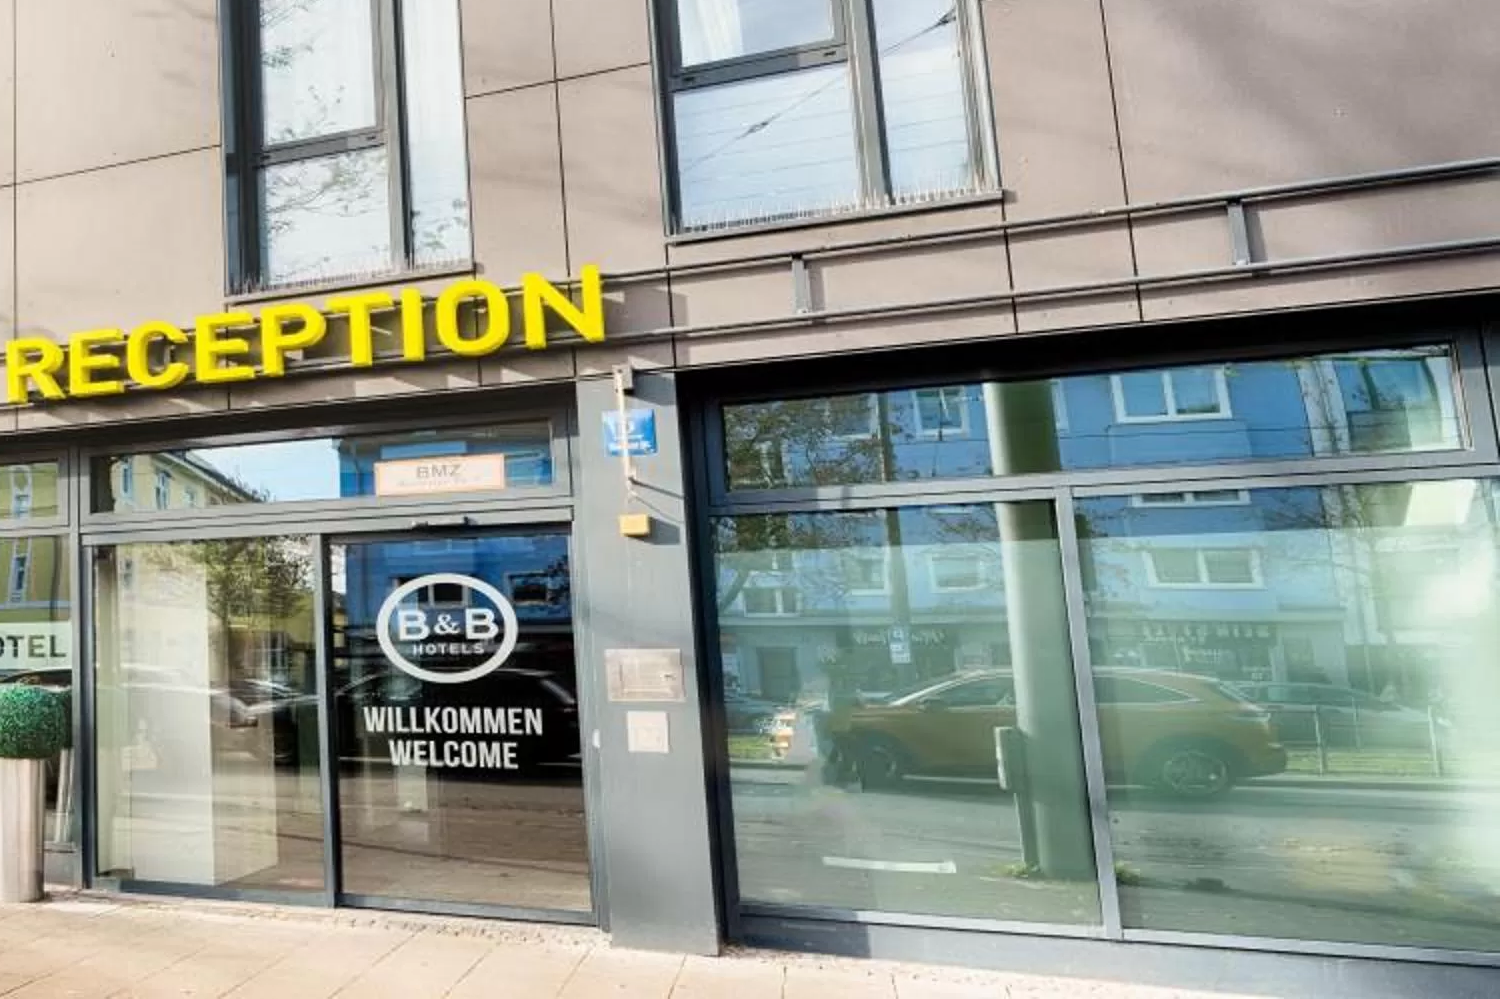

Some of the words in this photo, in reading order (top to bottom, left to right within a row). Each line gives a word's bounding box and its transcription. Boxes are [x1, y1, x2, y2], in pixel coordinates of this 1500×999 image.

[4, 264, 606, 406] RECEPTION
[397, 607, 499, 641] B&B
[413, 642, 485, 656] HOTELS
[363, 706, 543, 736] WILLKOMMEN
[388, 739, 519, 770] WELCOME
